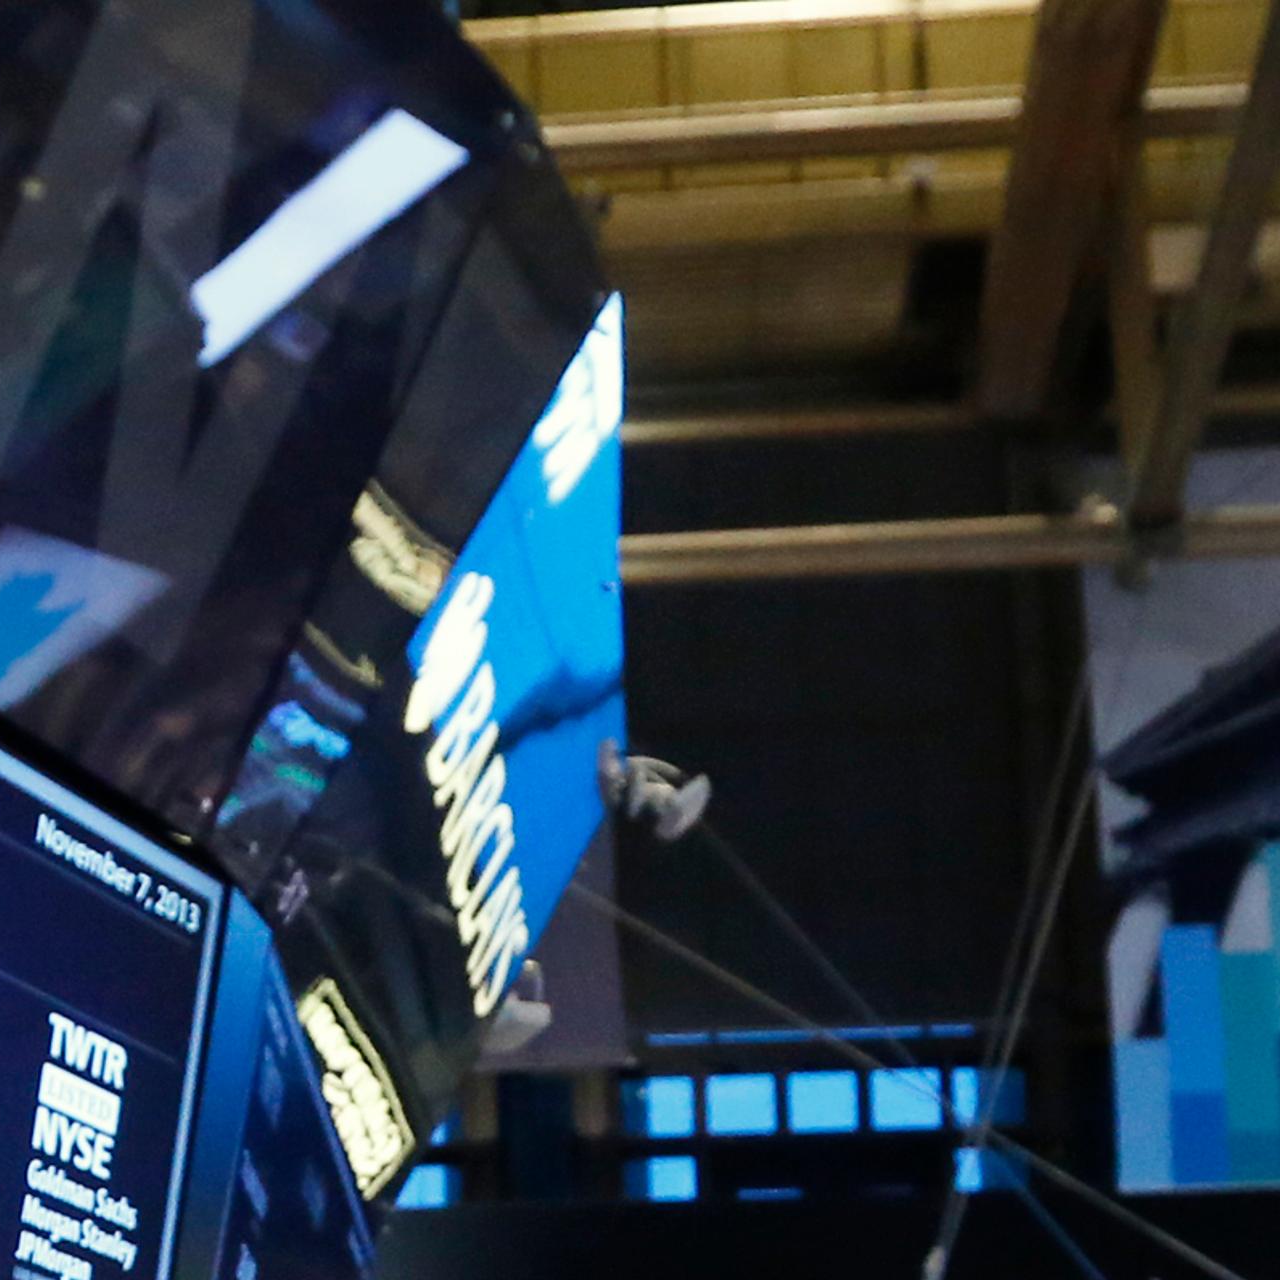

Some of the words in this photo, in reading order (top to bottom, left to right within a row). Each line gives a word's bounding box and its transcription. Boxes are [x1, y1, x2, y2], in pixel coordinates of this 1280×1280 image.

[35, 812, 136, 897] November
[135, 872, 154, 912] 7,
[154, 884, 201, 934] 2013
[47, 1011, 128, 1090] TWTR
[31, 1104, 116, 1180] NYSE
